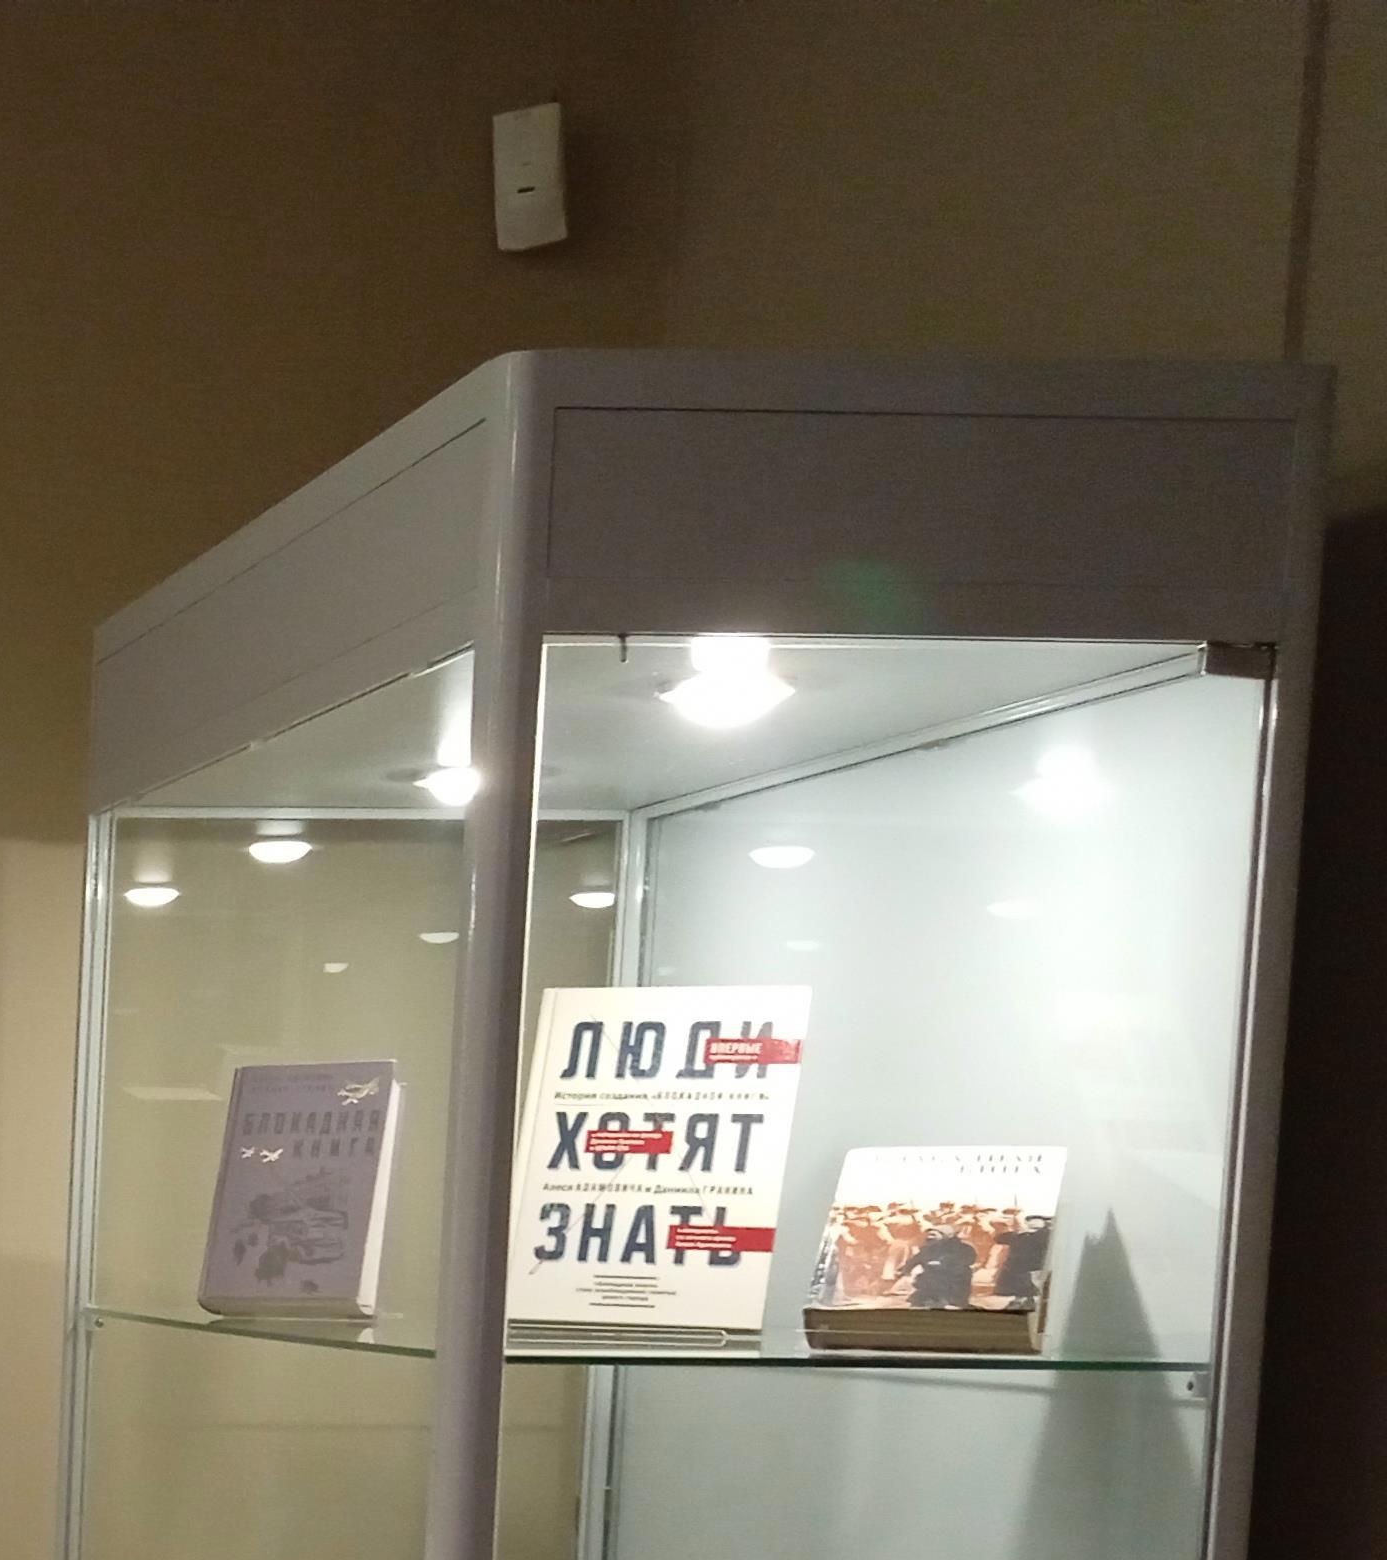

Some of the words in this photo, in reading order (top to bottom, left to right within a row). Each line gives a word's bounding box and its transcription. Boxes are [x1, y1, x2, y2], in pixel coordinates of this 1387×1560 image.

[560, 1021, 774, 1079] ЛЮДИ
[242, 1108, 381, 1136] БЛОКАДНАЯ
[292, 1136, 376, 1159] КНИГА
[547, 1111, 765, 1173] ХОТЯТ
[534, 1202, 741, 1266] ЗНАТЬ
